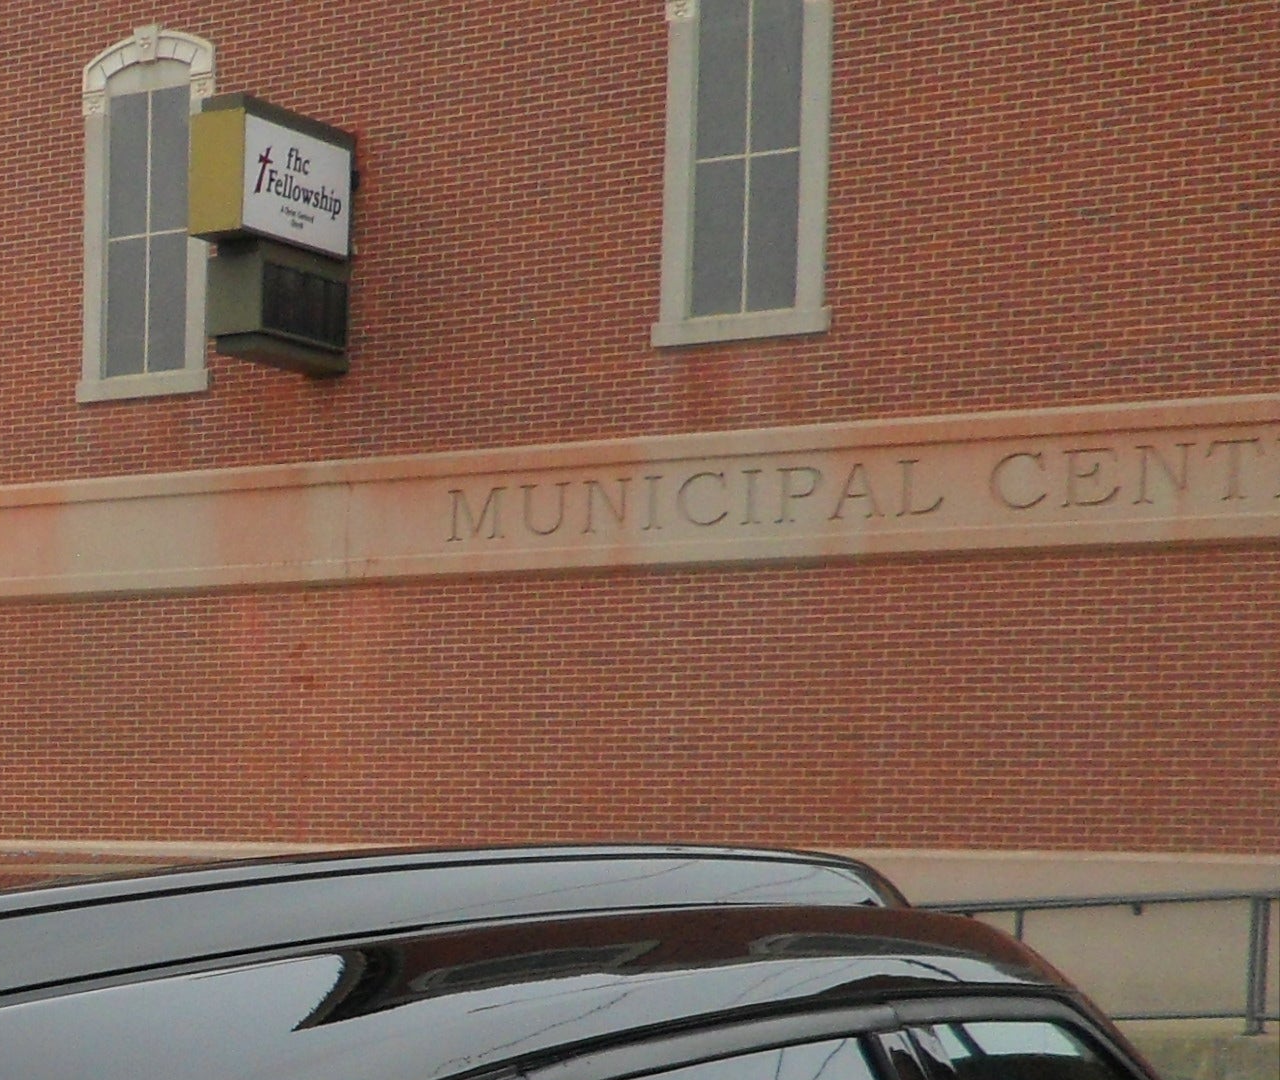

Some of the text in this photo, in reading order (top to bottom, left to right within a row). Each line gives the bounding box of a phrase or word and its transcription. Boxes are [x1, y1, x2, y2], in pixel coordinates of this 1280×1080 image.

[286, 147, 310, 175] fhc
[266, 169, 342, 220] Fellowship
[446, 436, 1280, 543] MUNICIPAL CENT
